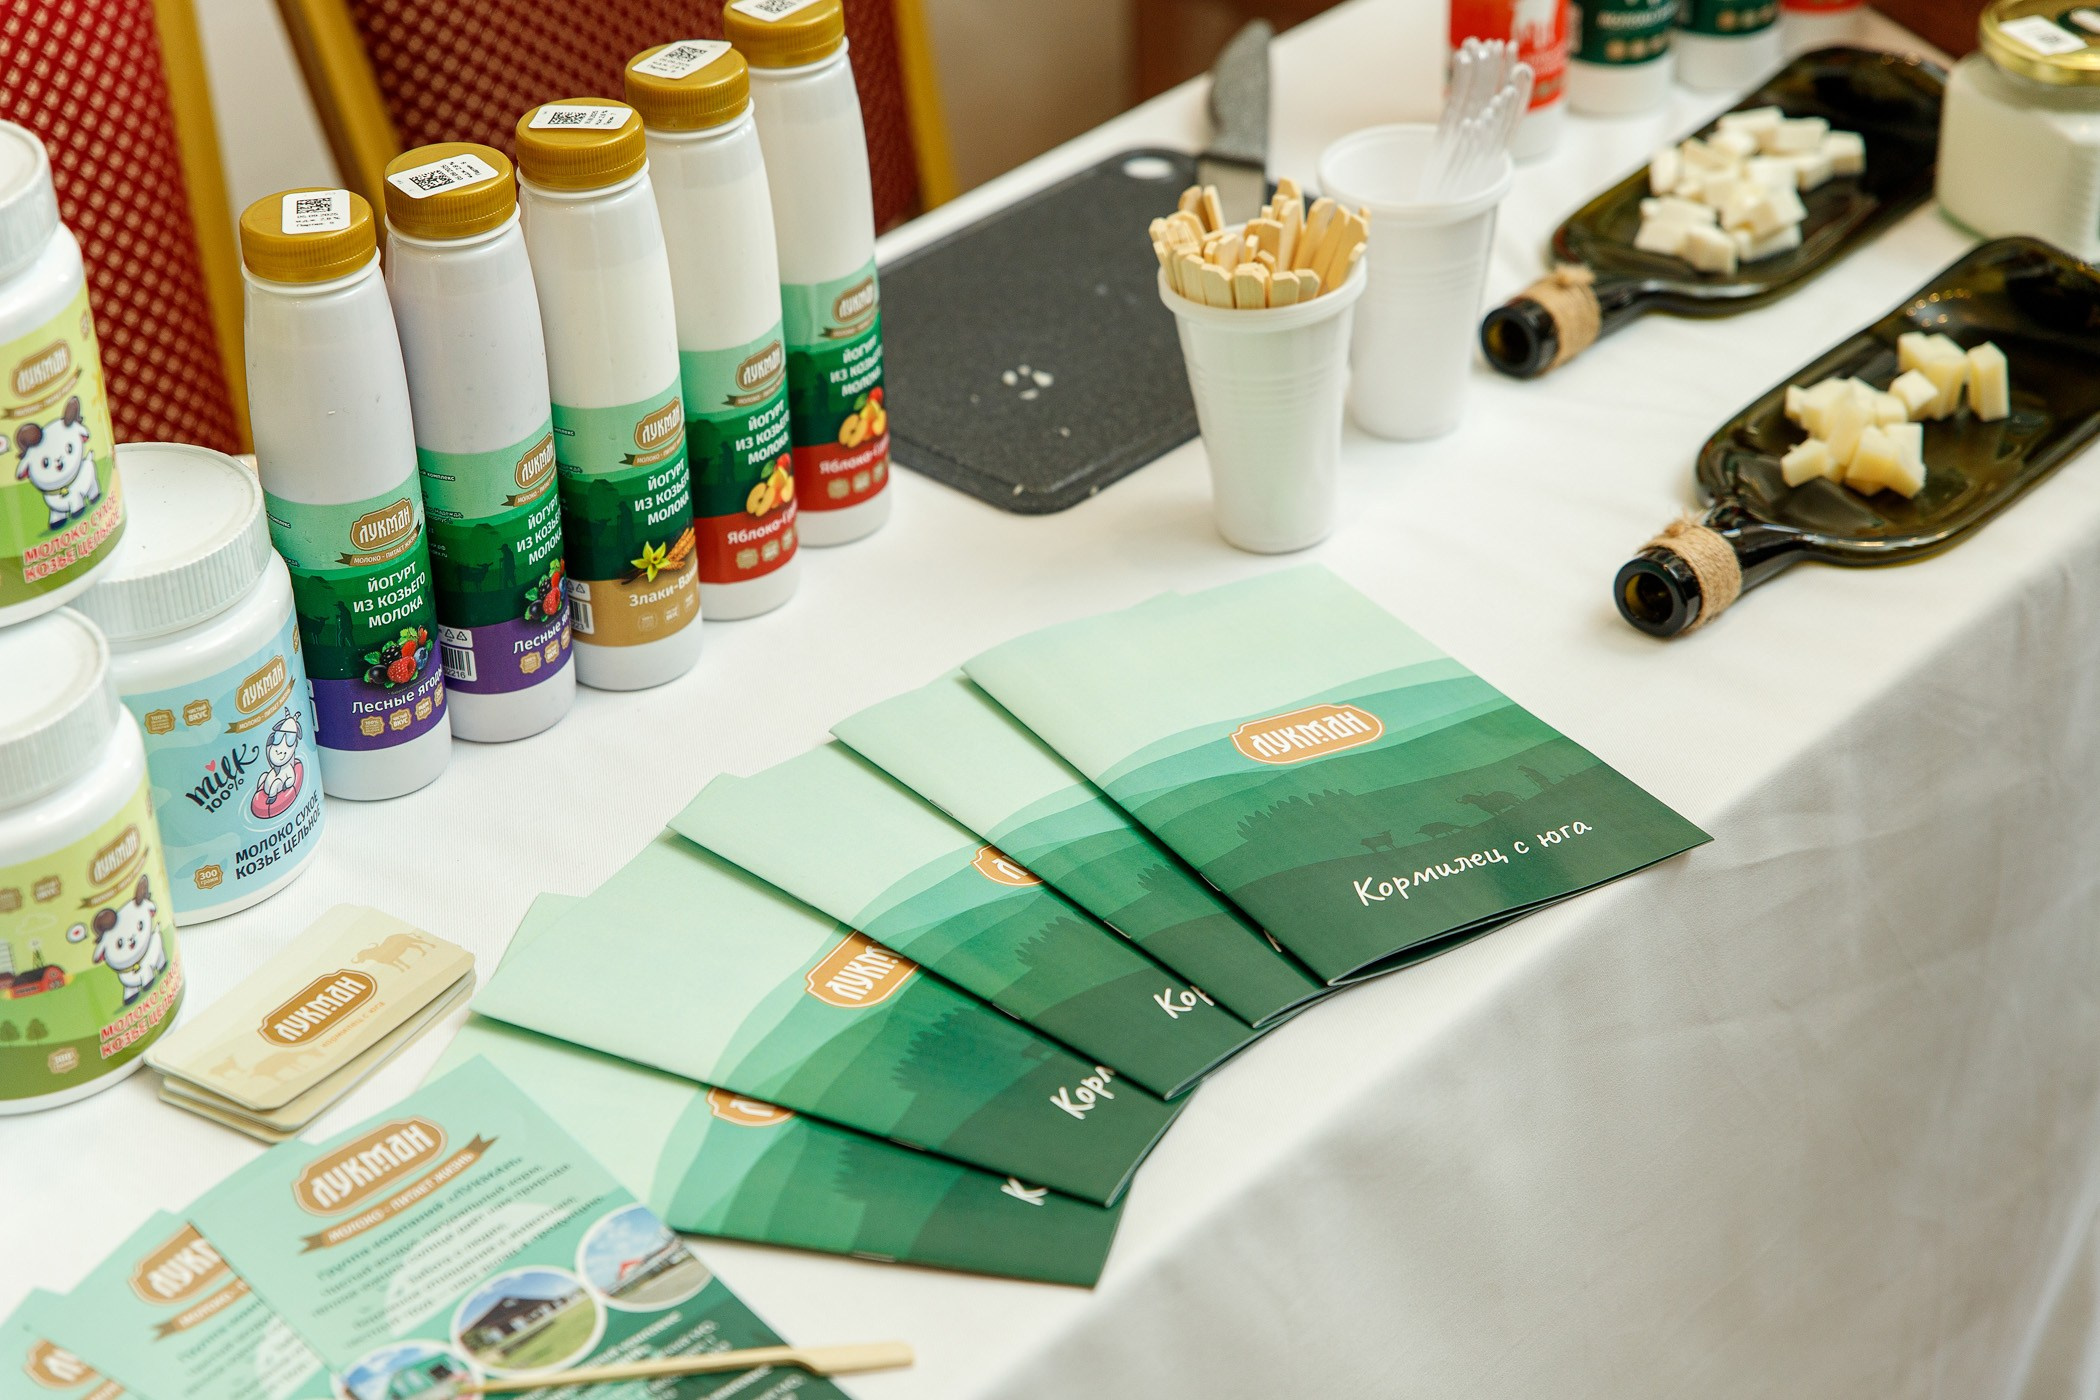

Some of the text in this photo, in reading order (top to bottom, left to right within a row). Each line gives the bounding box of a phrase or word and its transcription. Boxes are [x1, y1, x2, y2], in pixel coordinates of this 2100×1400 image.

[830, 368, 848, 384] ИЗ
[642, 405, 680, 443] ЛУКМАН
[748, 399, 784, 431] ЙОГУРТ
[521, 440, 554, 483] ЛУКМАН
[735, 437, 754, 452] ИЗ
[747, 431, 789, 465] МОЛОКА
[634, 468, 689, 512] ИЗ КОЗЬЕГО
[648, 458, 685, 491] ЙОГУРТ
[359, 506, 411, 544] ЛУКМАН
[528, 494, 558, 530] ЙОГУРТ
[647, 491, 689, 526] МОЛОКА
[24, 520, 89, 564] МОЛОКО
[353, 555, 381, 564] МОЛОКО
[385, 545, 405, 559] ПИТАЕТ
[516, 536, 533, 553] ИЗ
[23, 547, 77, 583] КОЗЬЕ
[368, 561, 416, 592] ЙОГУРТ
[353, 571, 426, 613] ИЗ КОЗЬЕГО
[368, 595, 423, 628] МОЛОКА
[513, 621, 561, 654] Лесные
[242, 662, 285, 708] ЛУКМАН
[352, 691, 415, 714] Лесные
[188, 710, 208, 722] ВКУС
[239, 715, 262, 730] МОЛОКО
[1249, 711, 1372, 758] ЛУКМАН
[185, 744, 259, 807] milk
[204, 778, 244, 814] 100%
[235, 790, 318, 864] МОЛОКО СУХОЕ
[235, 803, 321, 880] КОЗЬЕ ЦЕЛЬНОЕ
[200, 869, 218, 880] 300
[1352, 819, 1593, 906] Кормилец с юга
[825, 945, 904, 1001] ЛУКМ
[100, 991, 159, 1042] МОЛОКО
[273, 976, 367, 1042] ЛУКМАН
[100, 1018, 149, 1059] КОЗЬЕ
[310, 1124, 435, 1209] ЛУКМАН
[327, 1208, 386, 1243] МОЛОКО
[390, 1178, 433, 1211] ПИТАЕТ
[432, 1152, 475, 1184] ЖИЗНЬ
[146, 1237, 221, 1299] ЛУК
